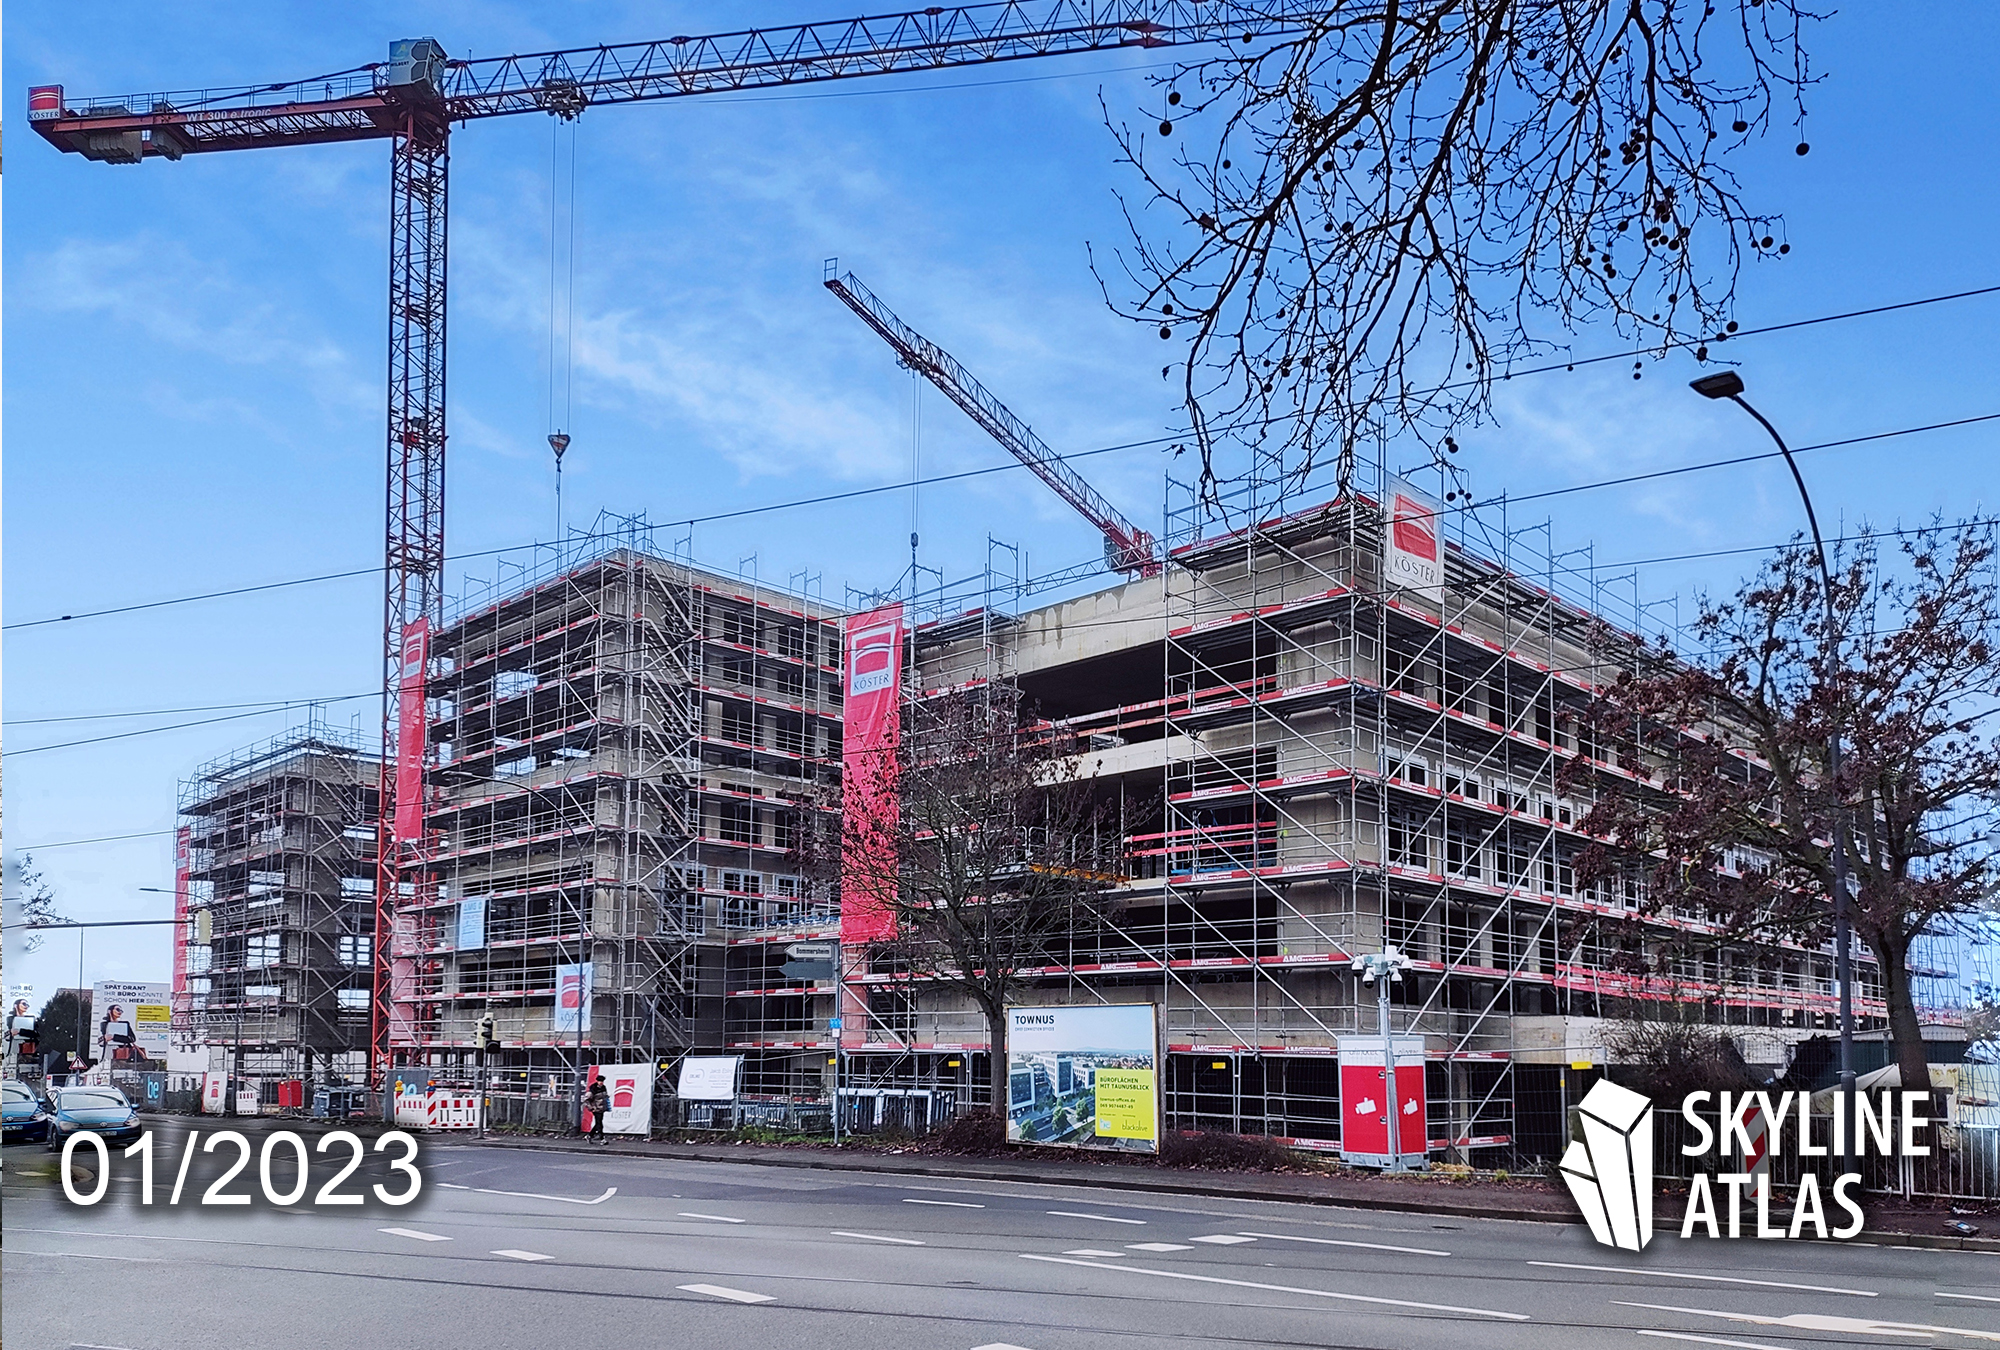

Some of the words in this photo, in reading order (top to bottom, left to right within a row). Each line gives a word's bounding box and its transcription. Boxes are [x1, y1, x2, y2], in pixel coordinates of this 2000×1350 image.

[186, 113, 204, 122] WT
[207, 111, 228, 120] 300
[1394, 555, 1435, 584] KÖSTER
[853, 673, 890, 691] KÖSTER
[1282, 687, 1302, 697] AMG
[1282, 775, 1302, 785] AMG
[1282, 864, 1302, 874] AMG
[1191, 874, 1209, 882] AMG
[1283, 954, 1303, 963] AMG
[1014, 1015, 1055, 1025] TOWNUS
[147, 1075, 159, 1100] be
[1111, 1083, 1150, 1091] TAUNUSBLICK
[610, 1109, 632, 1119] KÖSTER
